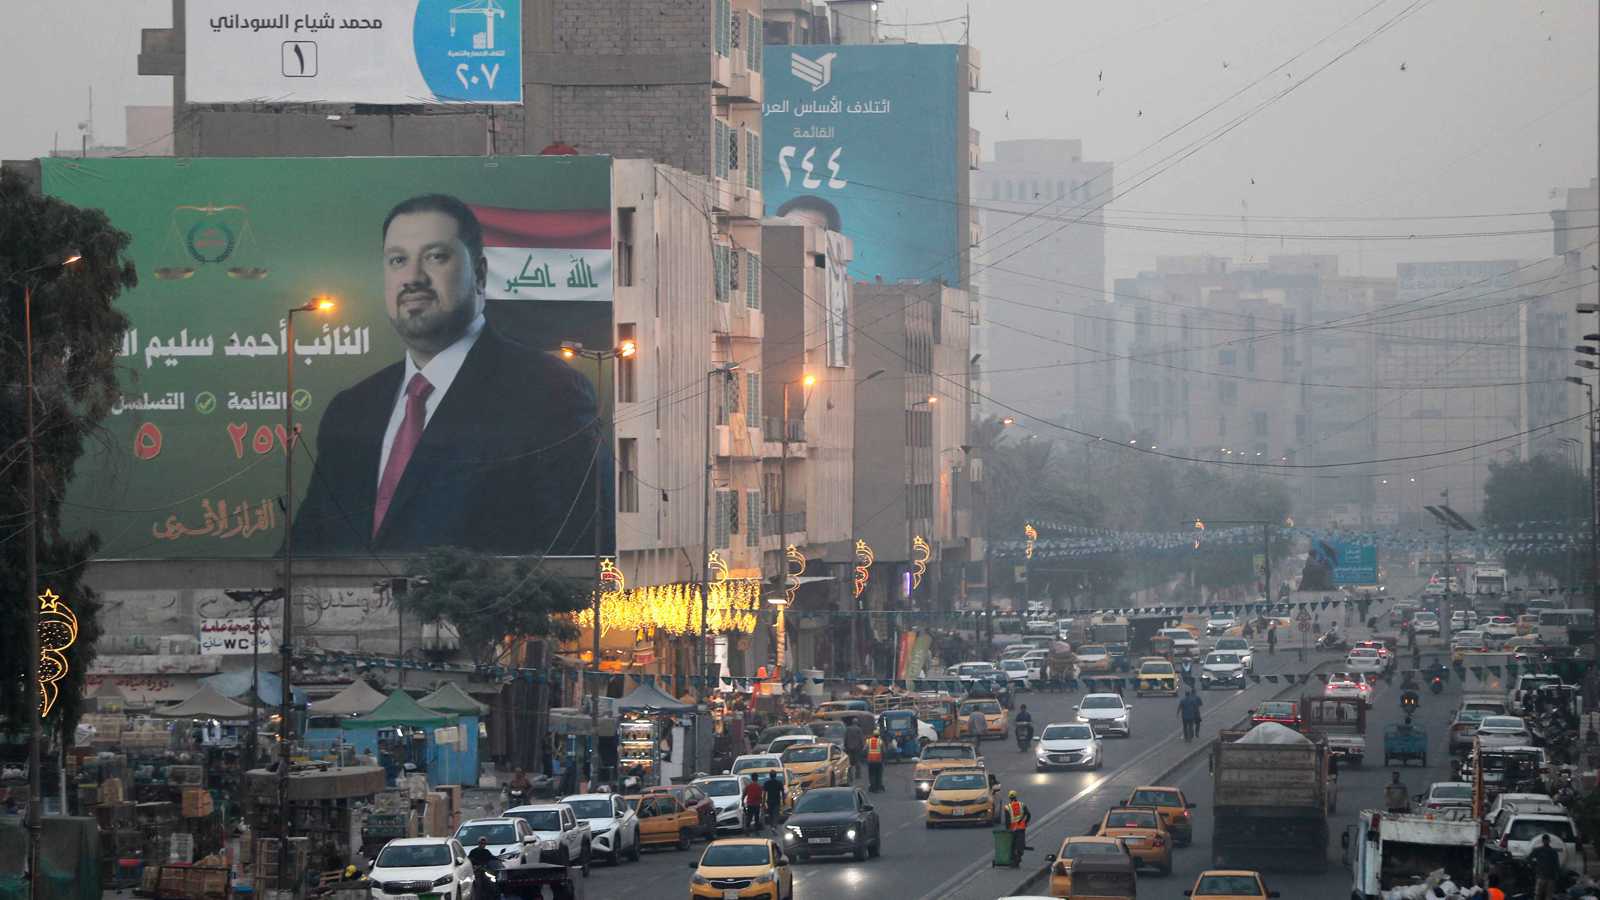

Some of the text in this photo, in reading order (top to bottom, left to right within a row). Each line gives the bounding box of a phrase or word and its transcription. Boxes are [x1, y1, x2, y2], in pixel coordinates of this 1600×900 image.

[209, 12, 383, 32] محمد شياع السوداني
[455, 63, 500, 90] ٢٠٧
[761, 99, 790, 117] العرا
[793, 95, 843, 117] الأساس
[792, 126, 835, 139] القائمة
[778, 145, 848, 189] ٢٤٤
[145, 328, 215, 369] سليم
[224, 318, 288, 358] أحمد
[294, 324, 370, 365] النائب
[227, 391, 288, 411] القائمة
[134, 421, 163, 460] ٥
[223, 638, 250, 650] WC
